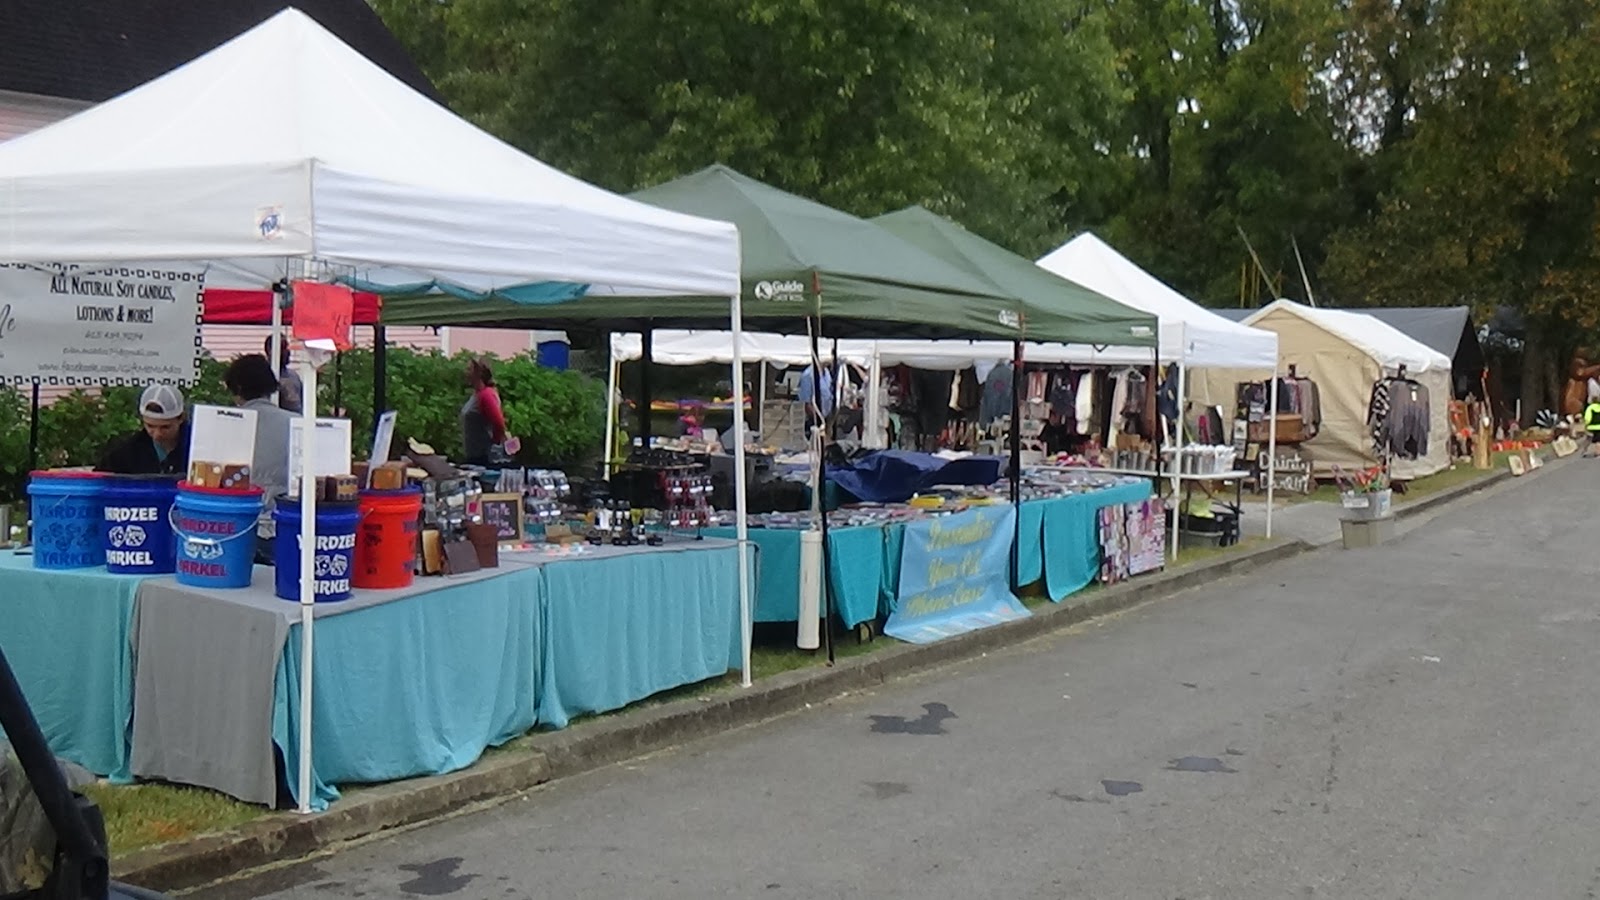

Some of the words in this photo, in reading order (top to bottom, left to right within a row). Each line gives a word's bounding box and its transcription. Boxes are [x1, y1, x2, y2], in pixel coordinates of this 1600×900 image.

[772, 280, 804, 292] Guide
[1259, 451, 1311, 474] Dainty
[296, 532, 357, 552] YRDZEE
[41, 551, 95, 566] YARKEL
